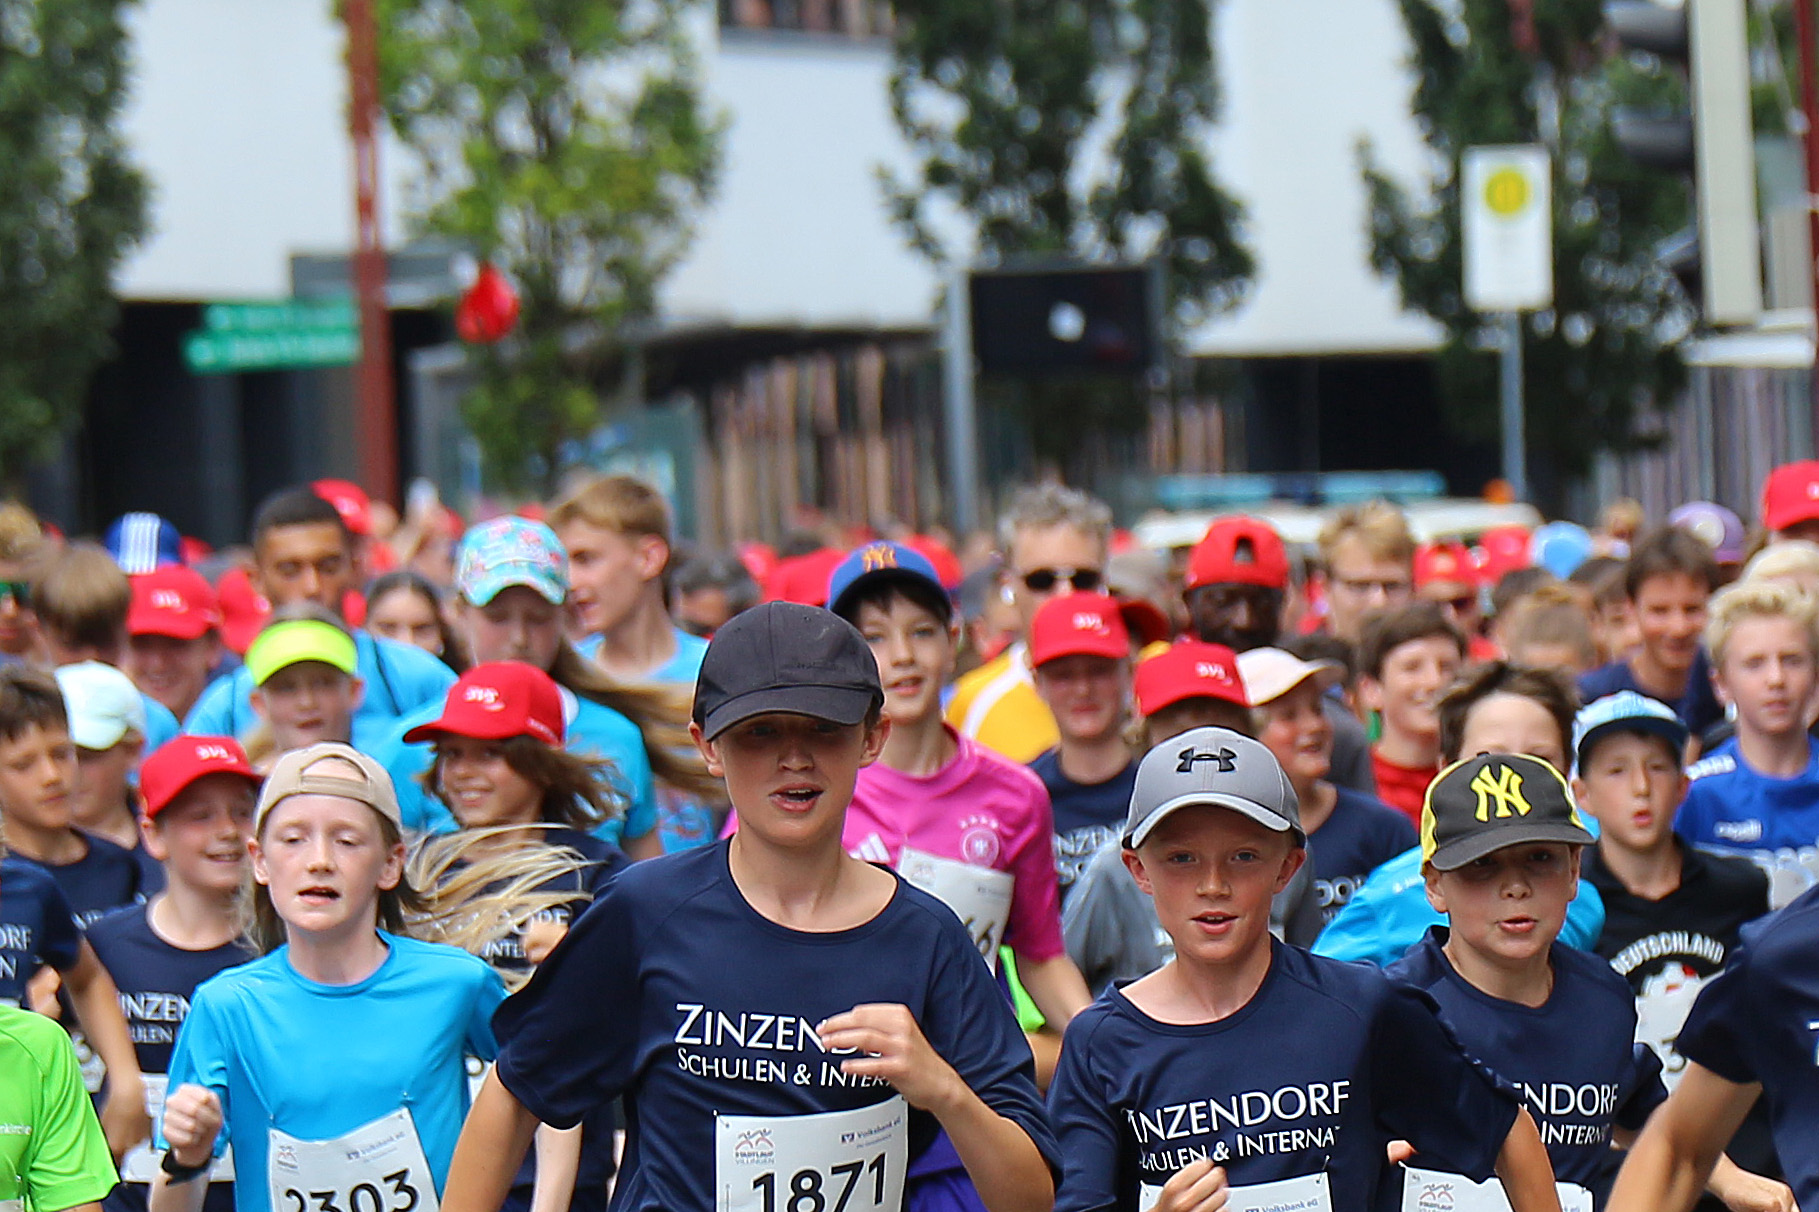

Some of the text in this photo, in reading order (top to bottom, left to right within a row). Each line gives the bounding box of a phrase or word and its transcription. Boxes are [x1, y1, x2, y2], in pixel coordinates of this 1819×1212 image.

[674, 1003, 883, 1058] ZINZEN
[677, 1047, 788, 1084] SCHULEN
[792, 1063, 812, 1086] &
[1124, 1080, 1351, 1146] INZENDORF
[1212, 1140, 1230, 1162] &
[1237, 1125, 1341, 1157] INTERNA
